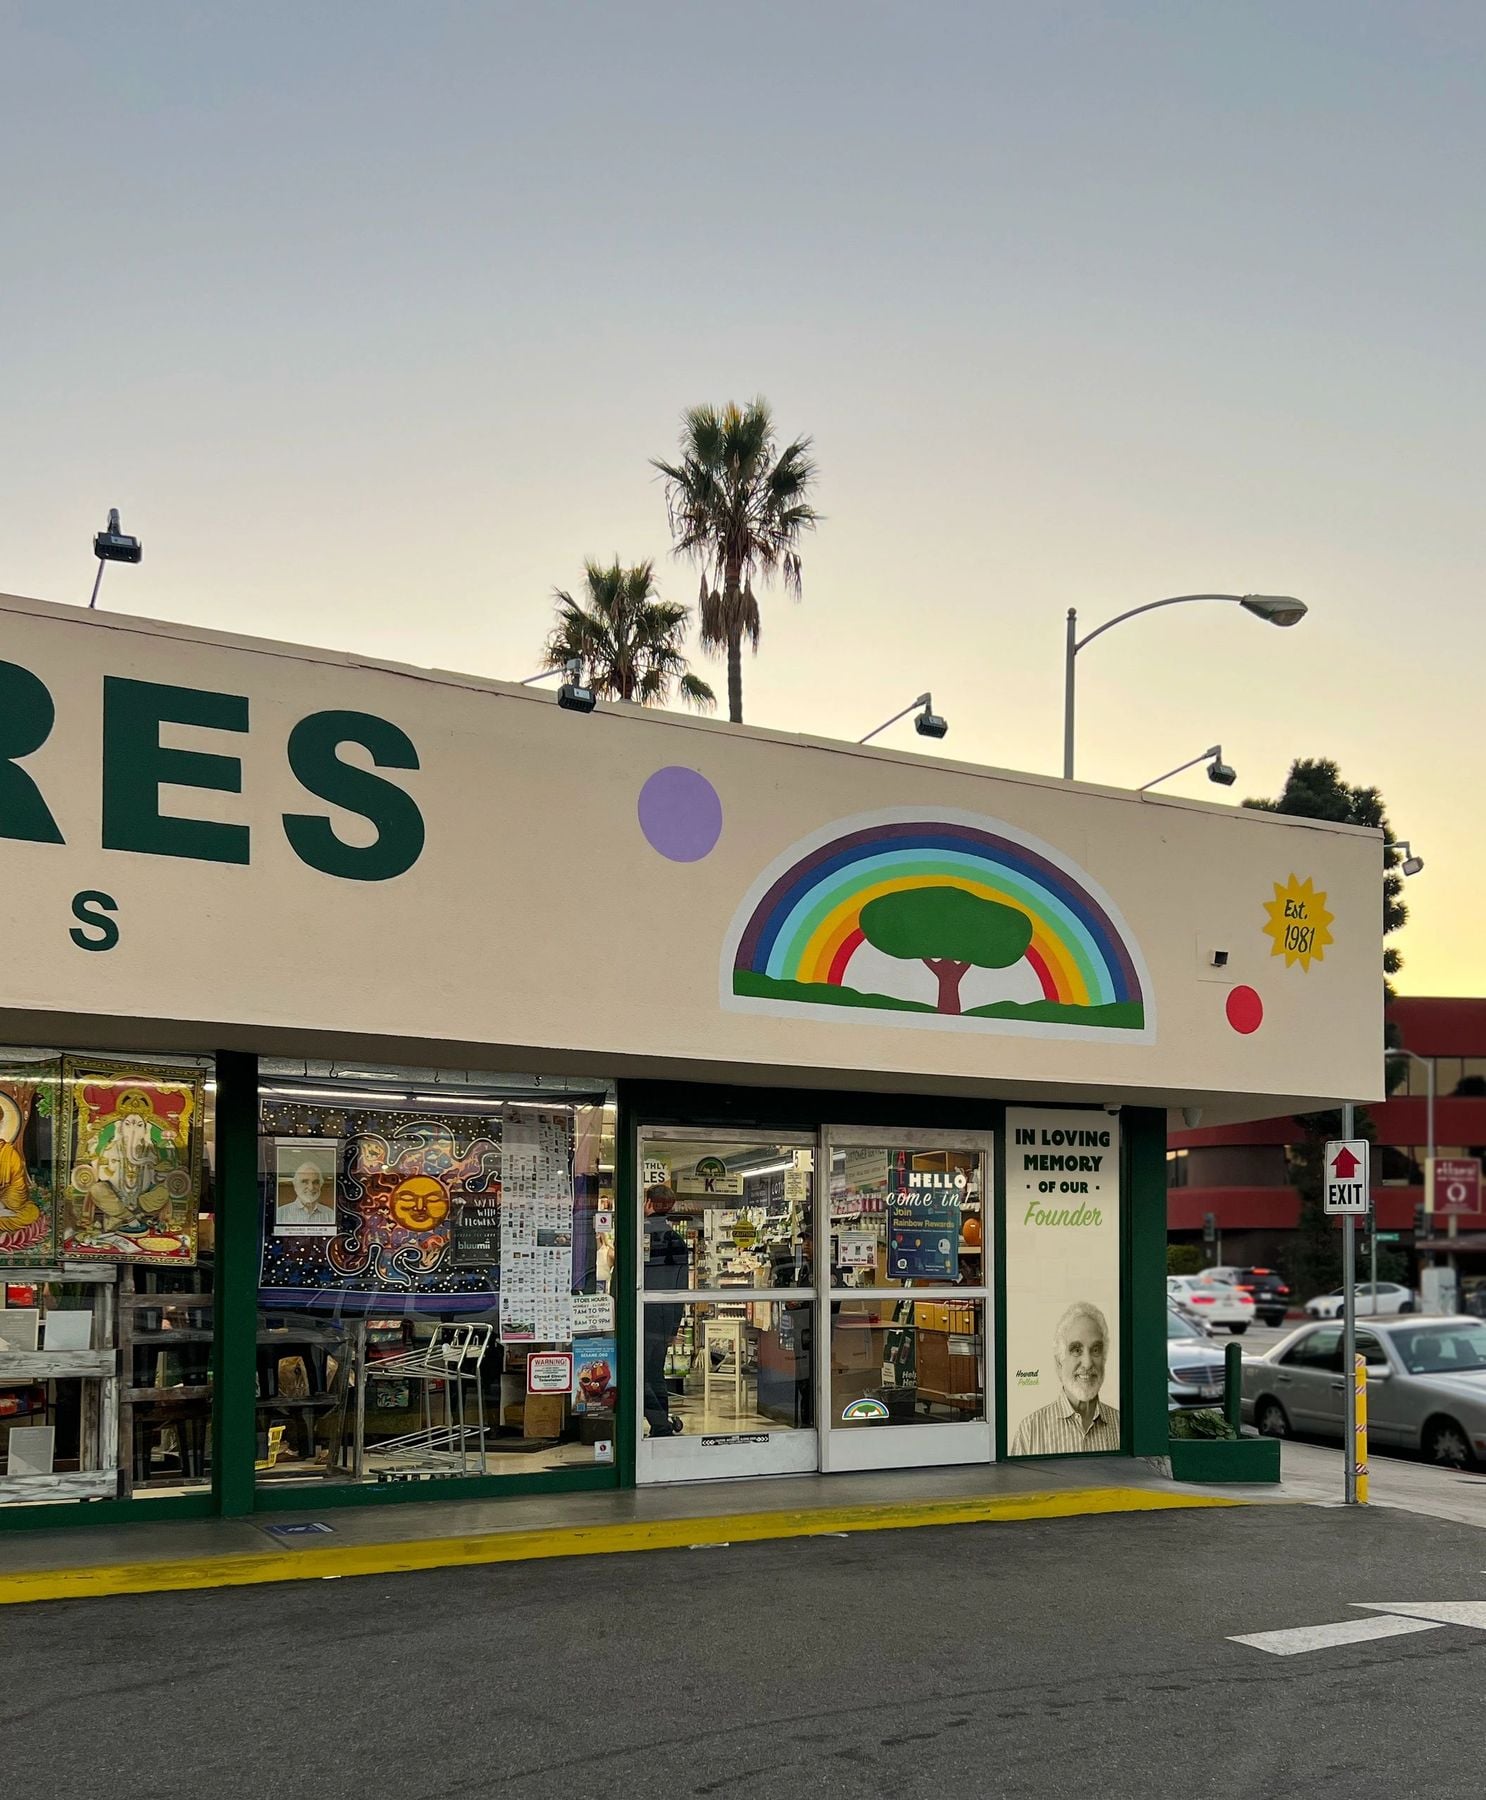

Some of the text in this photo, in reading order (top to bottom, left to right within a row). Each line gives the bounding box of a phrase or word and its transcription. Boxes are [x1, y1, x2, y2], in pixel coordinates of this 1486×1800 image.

[1284, 898, 1308, 920] Est.
[69, 889, 119, 952] S
[1284, 923, 1316, 954] 1981
[1015, 1128, 1110, 1148] IN LOVING
[1024, 1154, 1103, 1172] MEMORY
[704, 1178, 715, 1193] K
[908, 1173, 967, 1189] HELLO
[1038, 1181, 1089, 1194] OF OUR
[886, 1190, 933, 1206] come
[1329, 1184, 1363, 1205] EXIT
[893, 1208, 913, 1217] Join
[1024, 1200, 1103, 1226] Founder
[893, 1219, 955, 1229] Rainbow Rewards
